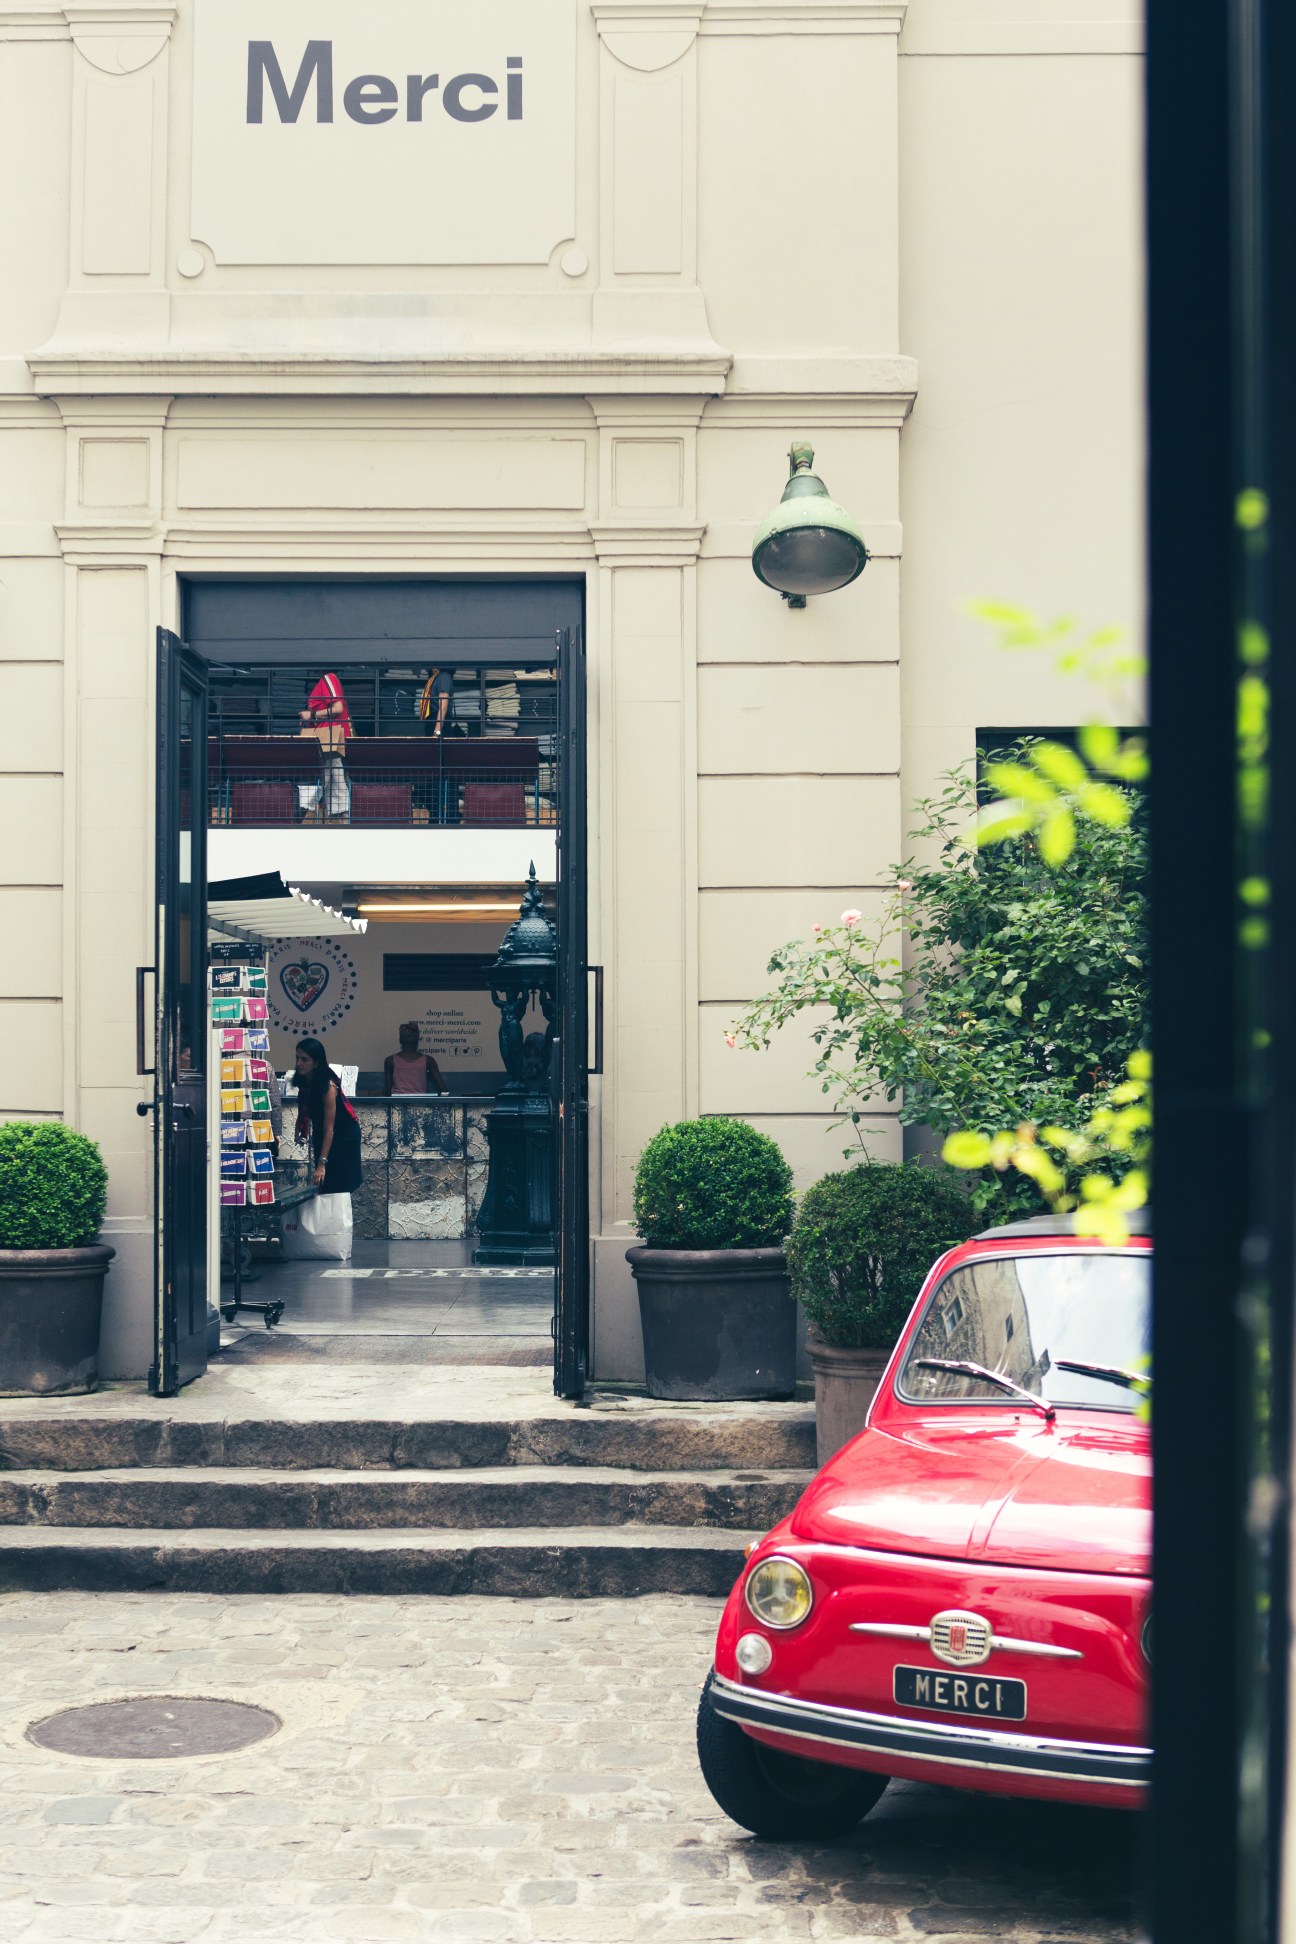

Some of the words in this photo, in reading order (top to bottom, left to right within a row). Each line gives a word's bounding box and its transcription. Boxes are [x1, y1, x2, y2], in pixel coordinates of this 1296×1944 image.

[246, 39, 523, 125] Merci
[299, 940, 323, 950] MERCI
[325, 949, 345, 973] PARIS
[340, 977, 348, 1000] MERCI
[282, 1015, 315, 1028] MERCI
[322, 1003, 342, 1022] PARIS
[426, 1009, 442, 1018] shop
[442, 1009, 464, 1017] online
[915, 1674, 1002, 1712] MERCI
